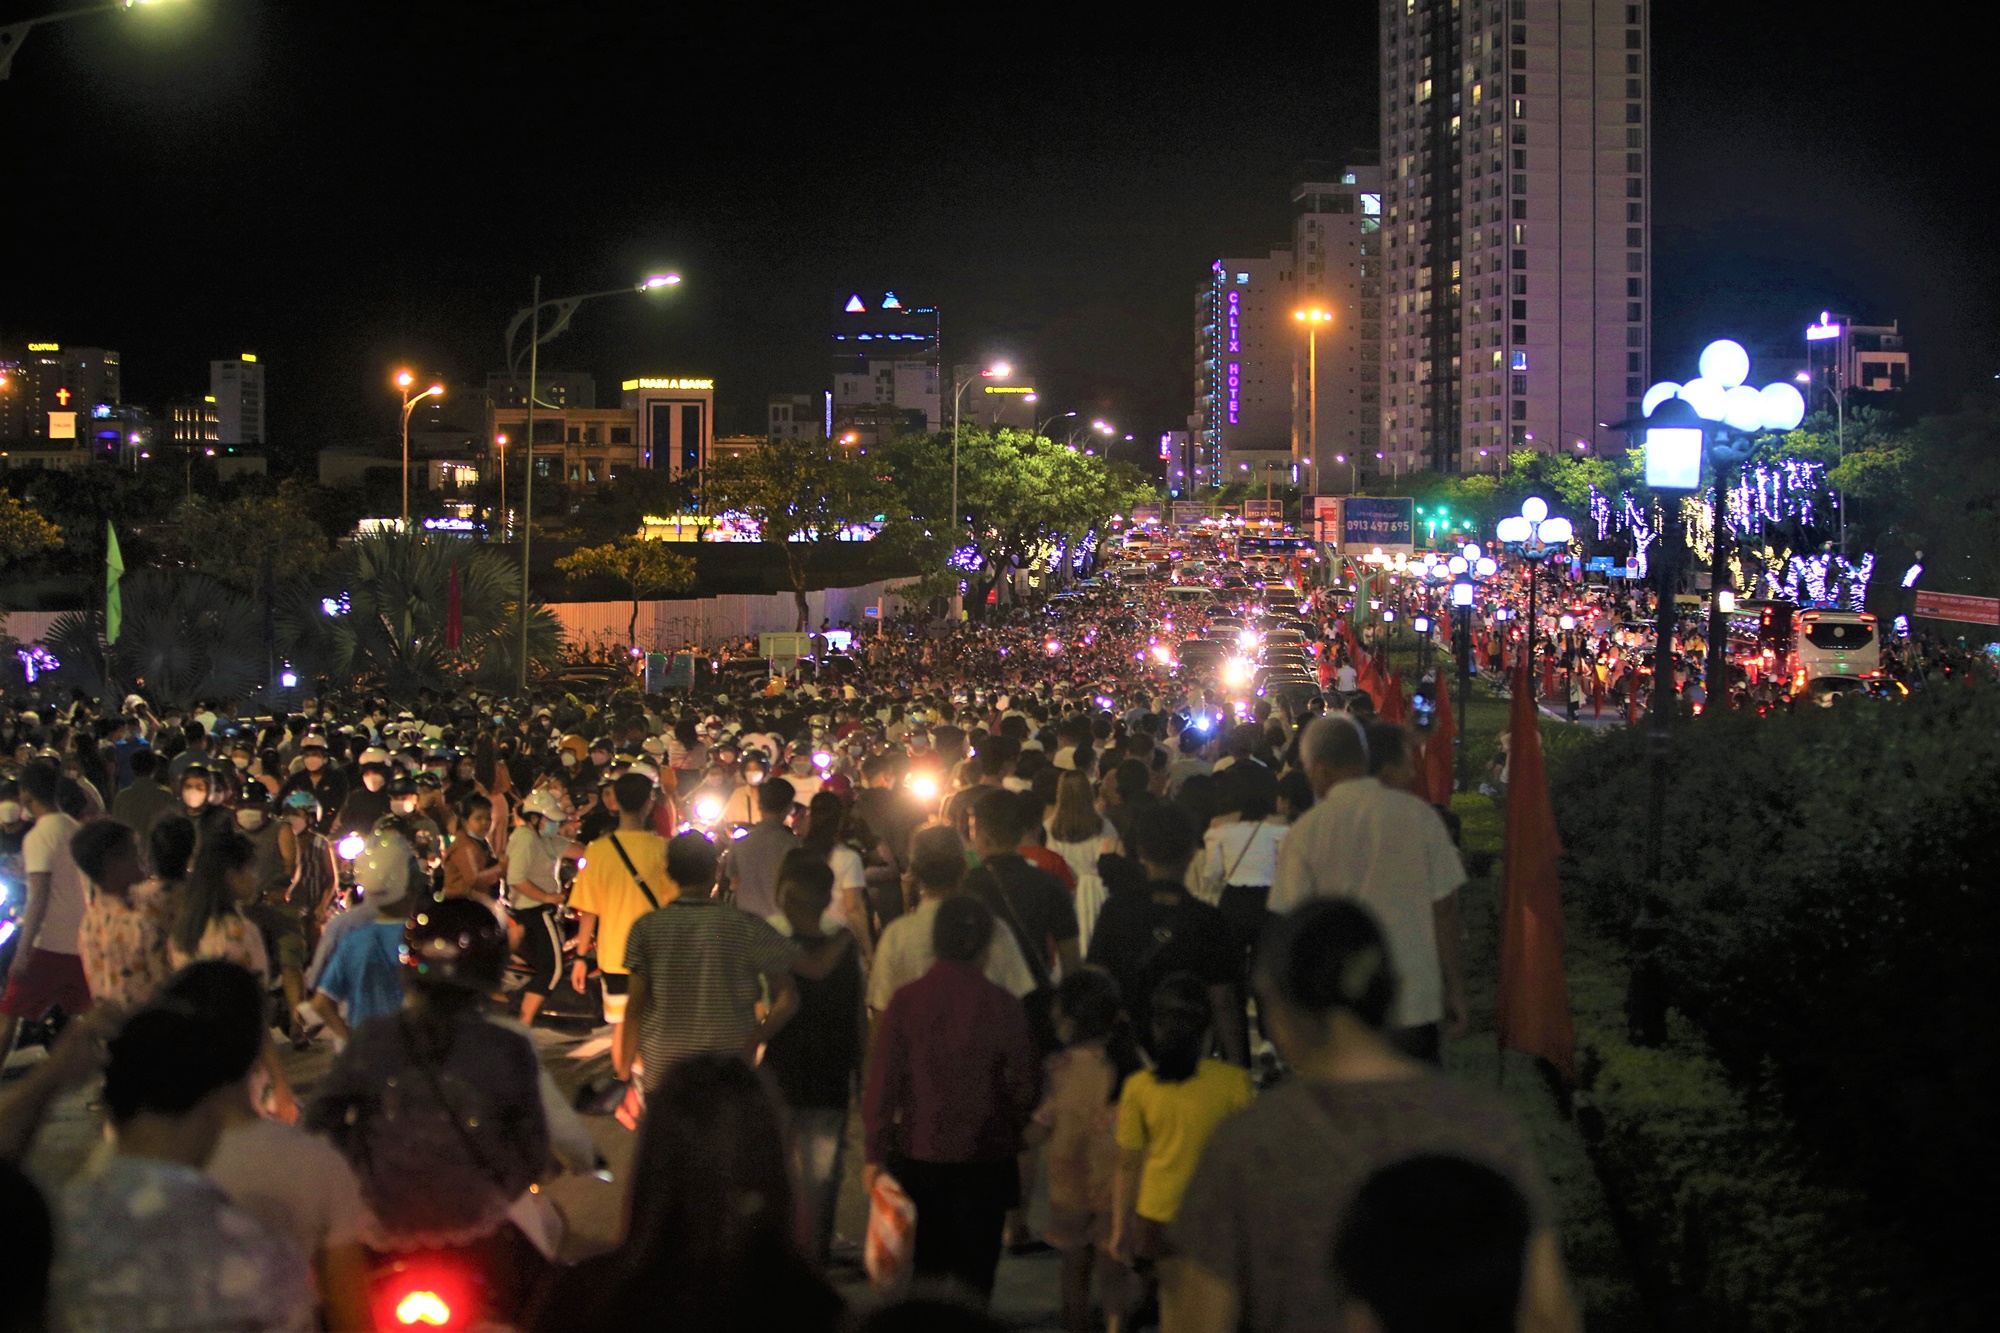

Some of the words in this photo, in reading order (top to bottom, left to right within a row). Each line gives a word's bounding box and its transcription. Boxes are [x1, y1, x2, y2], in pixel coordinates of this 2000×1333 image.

[1228, 292, 1240, 352] CALIX
[28, 343, 59, 351] CANVAS
[639, 379, 669, 389] NAM
[680, 379, 714, 389] BANK
[1228, 363, 1240, 424] HOTEL
[1347, 520, 1368, 531] 0913
[1370, 521, 1389, 532] 497
[1391, 521, 1410, 532] 695
